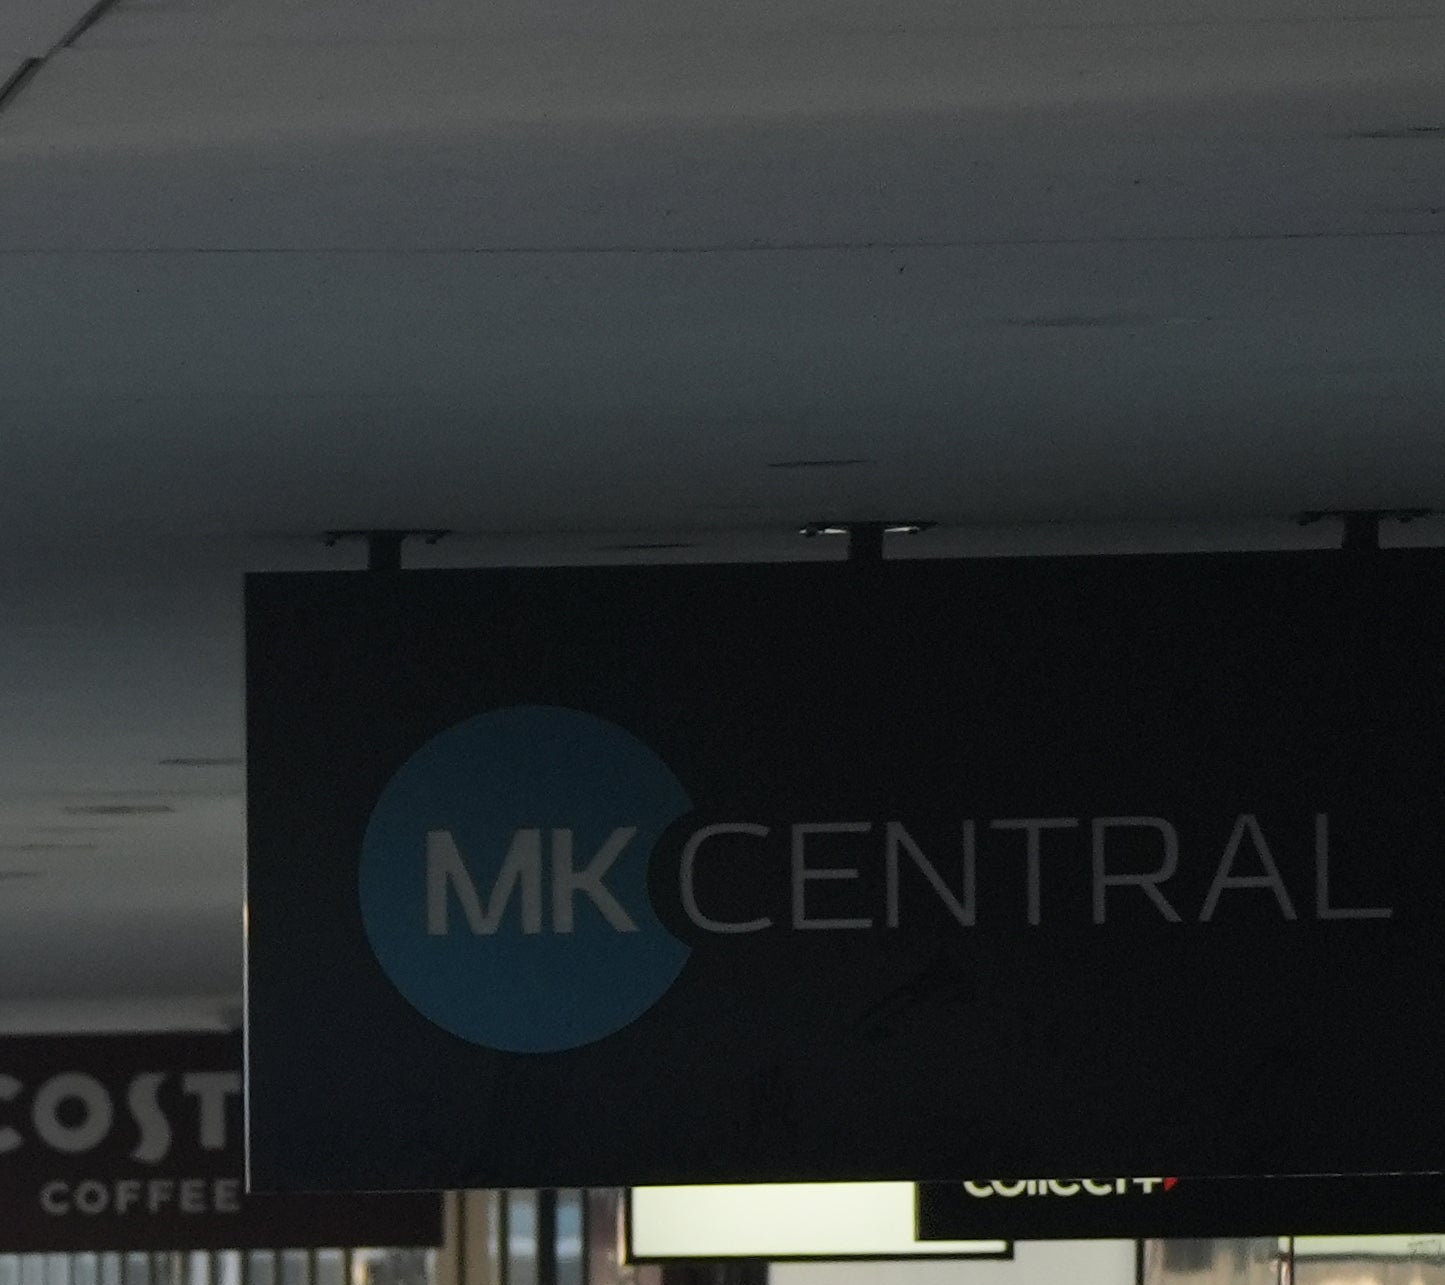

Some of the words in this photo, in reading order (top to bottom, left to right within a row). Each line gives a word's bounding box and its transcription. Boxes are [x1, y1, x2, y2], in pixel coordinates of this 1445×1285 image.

[425, 825, 641, 936] MK
[677, 812, 1394, 936] CENTRAL
[39, 1177, 243, 1216] COFFEE
